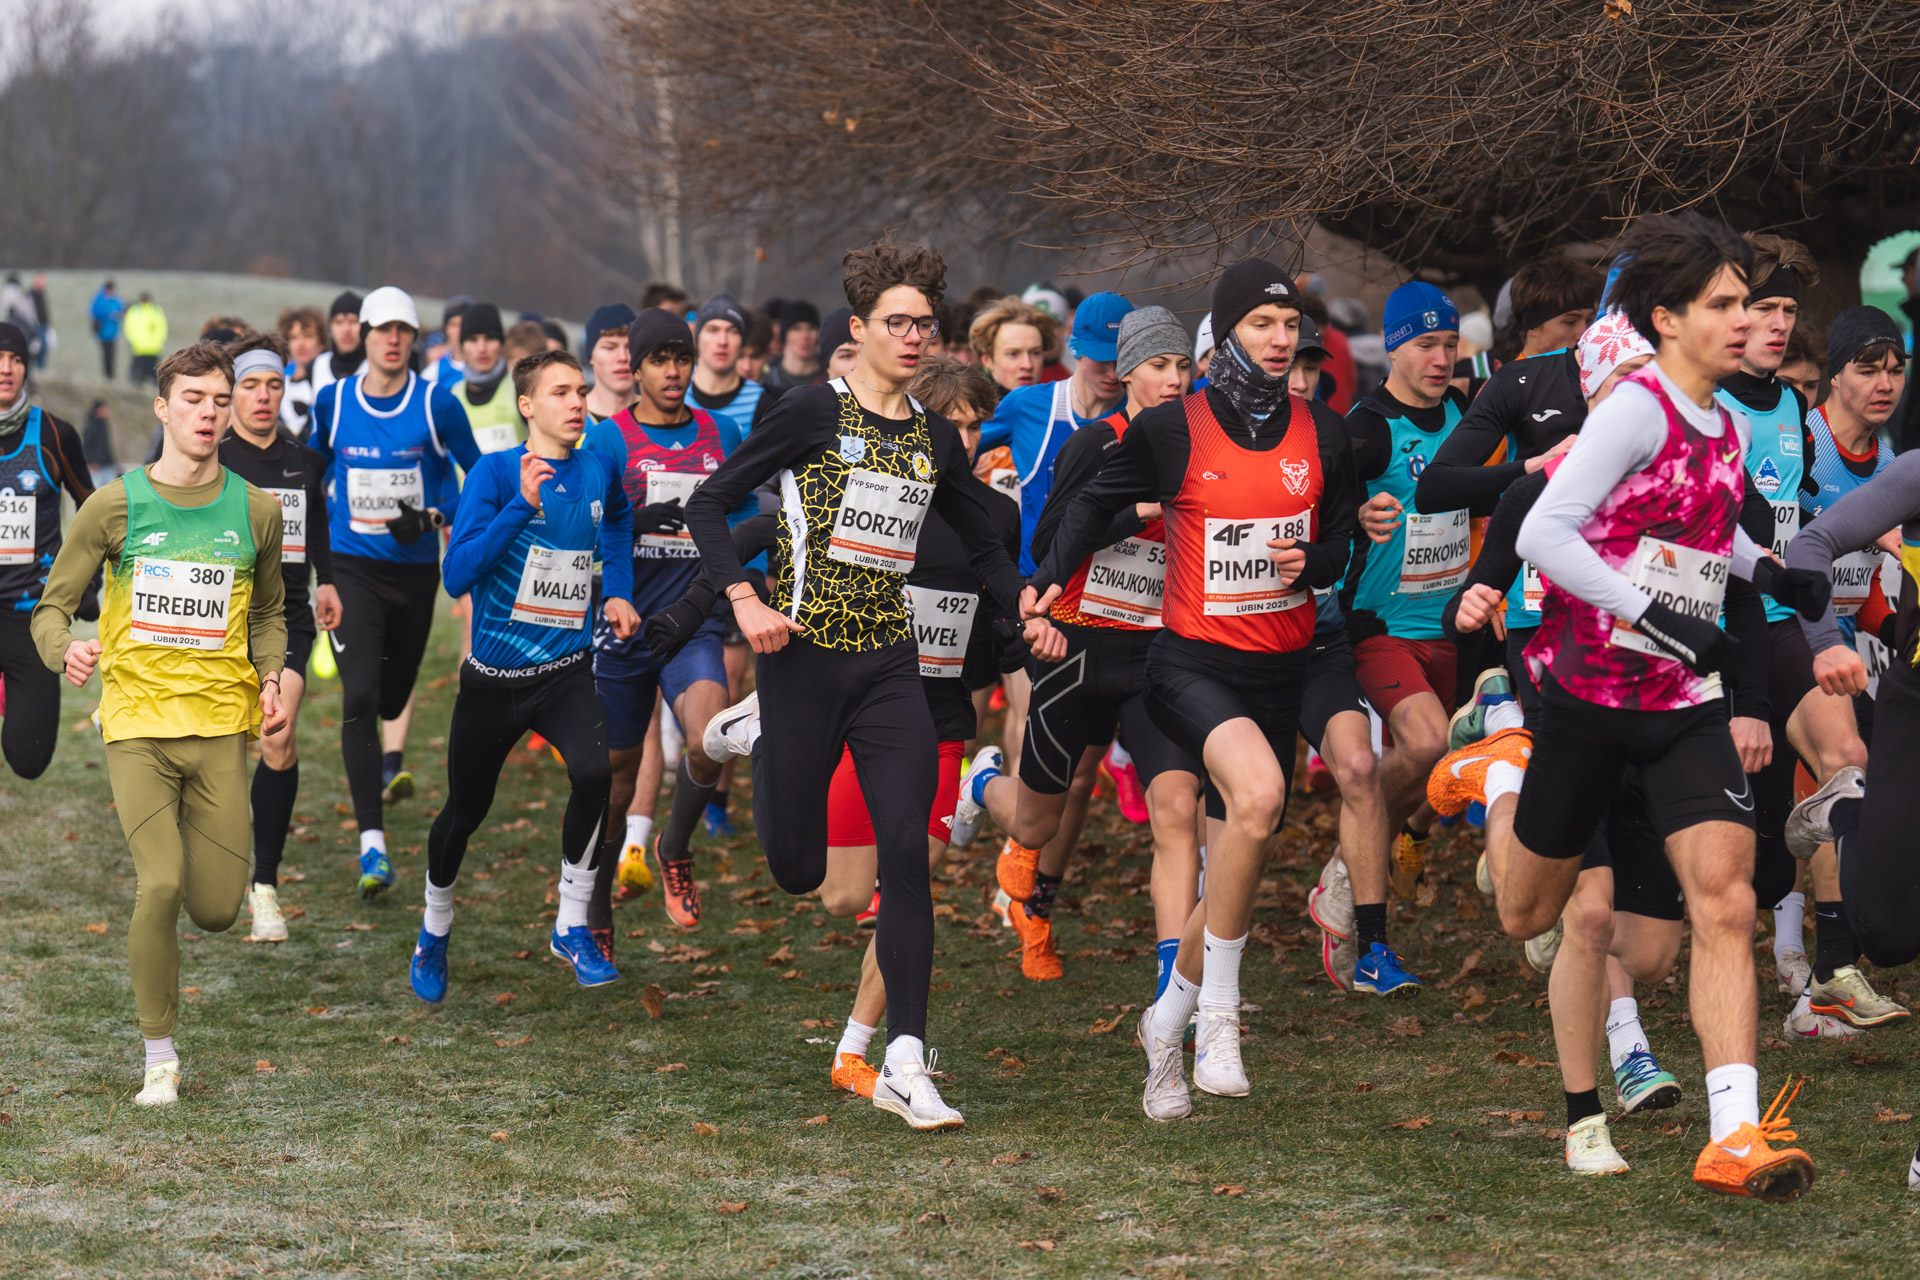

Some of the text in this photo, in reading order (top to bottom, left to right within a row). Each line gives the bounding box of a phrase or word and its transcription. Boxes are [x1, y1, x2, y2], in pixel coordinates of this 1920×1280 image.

[390, 472, 417, 486] 235
[850, 478, 890, 493] TVP SPORT
[898, 485, 929, 507] 262
[0, 500, 28, 513] 516
[841, 507, 919, 541] BORZYM
[1271, 518, 1304, 541] 188
[142, 531, 169, 546] 4F
[1213, 522, 1255, 546] 4F
[633, 546, 663, 558] MKL
[1406, 534, 1470, 565] SERKOWSKI
[572, 555, 591, 571] 424
[854, 554, 897, 569] LUBIN 2025
[189, 567, 225, 586] 380
[1209, 558, 1281, 582] PIMPI
[533, 579, 587, 601] WALAS
[135, 591, 225, 619] TEREBUN
[936, 596, 970, 614] 492
[1236, 599, 1289, 613] LUBIN 2025
[534, 615, 575, 627] LUBIN 2025
[1102, 607, 1146, 623] LUBIN 2025
[153, 634, 201, 646] LUBIN 2025
[469, 657, 498, 677] PRO
[498, 666, 538, 678] NIKE
[538, 657, 571, 674] PRO
[921, 666, 942, 675] 2025
[940, 814, 954, 830] 4
